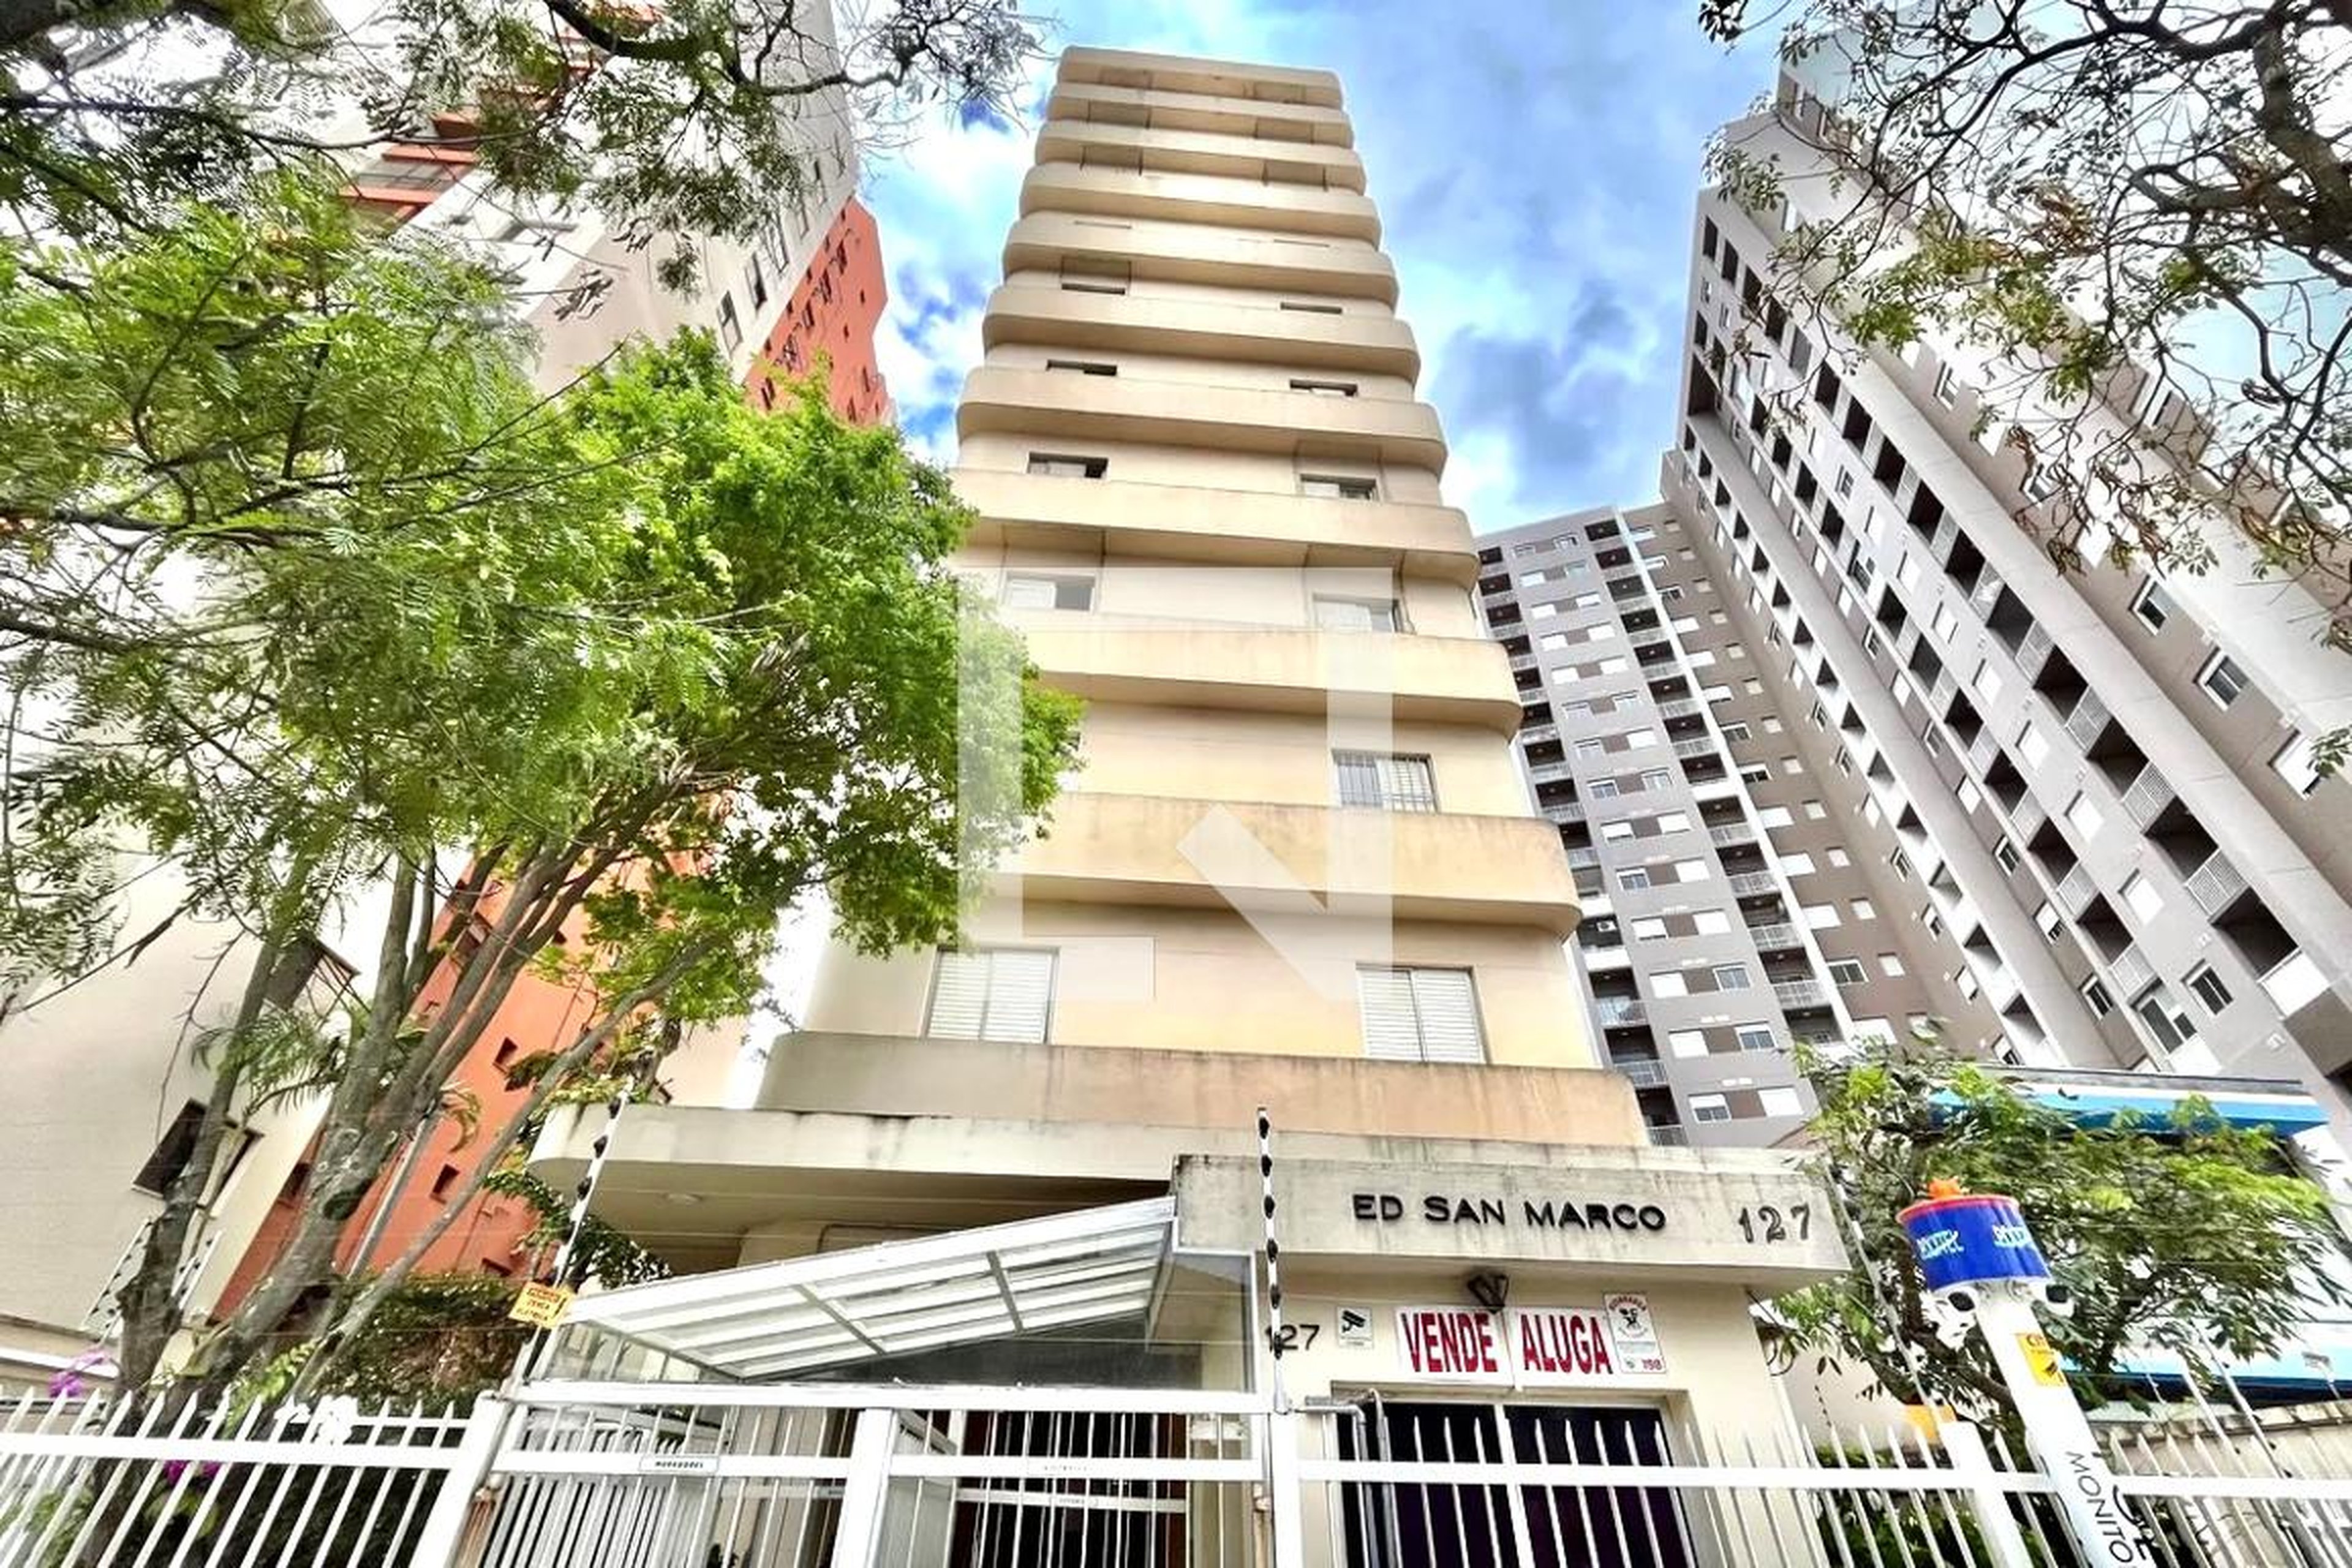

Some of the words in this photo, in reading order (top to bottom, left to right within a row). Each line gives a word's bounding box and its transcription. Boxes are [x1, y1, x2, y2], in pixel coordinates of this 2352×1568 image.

[1352, 1194, 1403, 1221] ED
[1423, 1196, 1506, 1226] SAN
[1523, 1200, 1667, 1231] MARCO
[1738, 1202, 1810, 1243] 127
[1401, 1312, 1499, 1373] VENDE
[1520, 1314, 1613, 1374] ALUGA
[2065, 1450, 2137, 1568] MONITO
